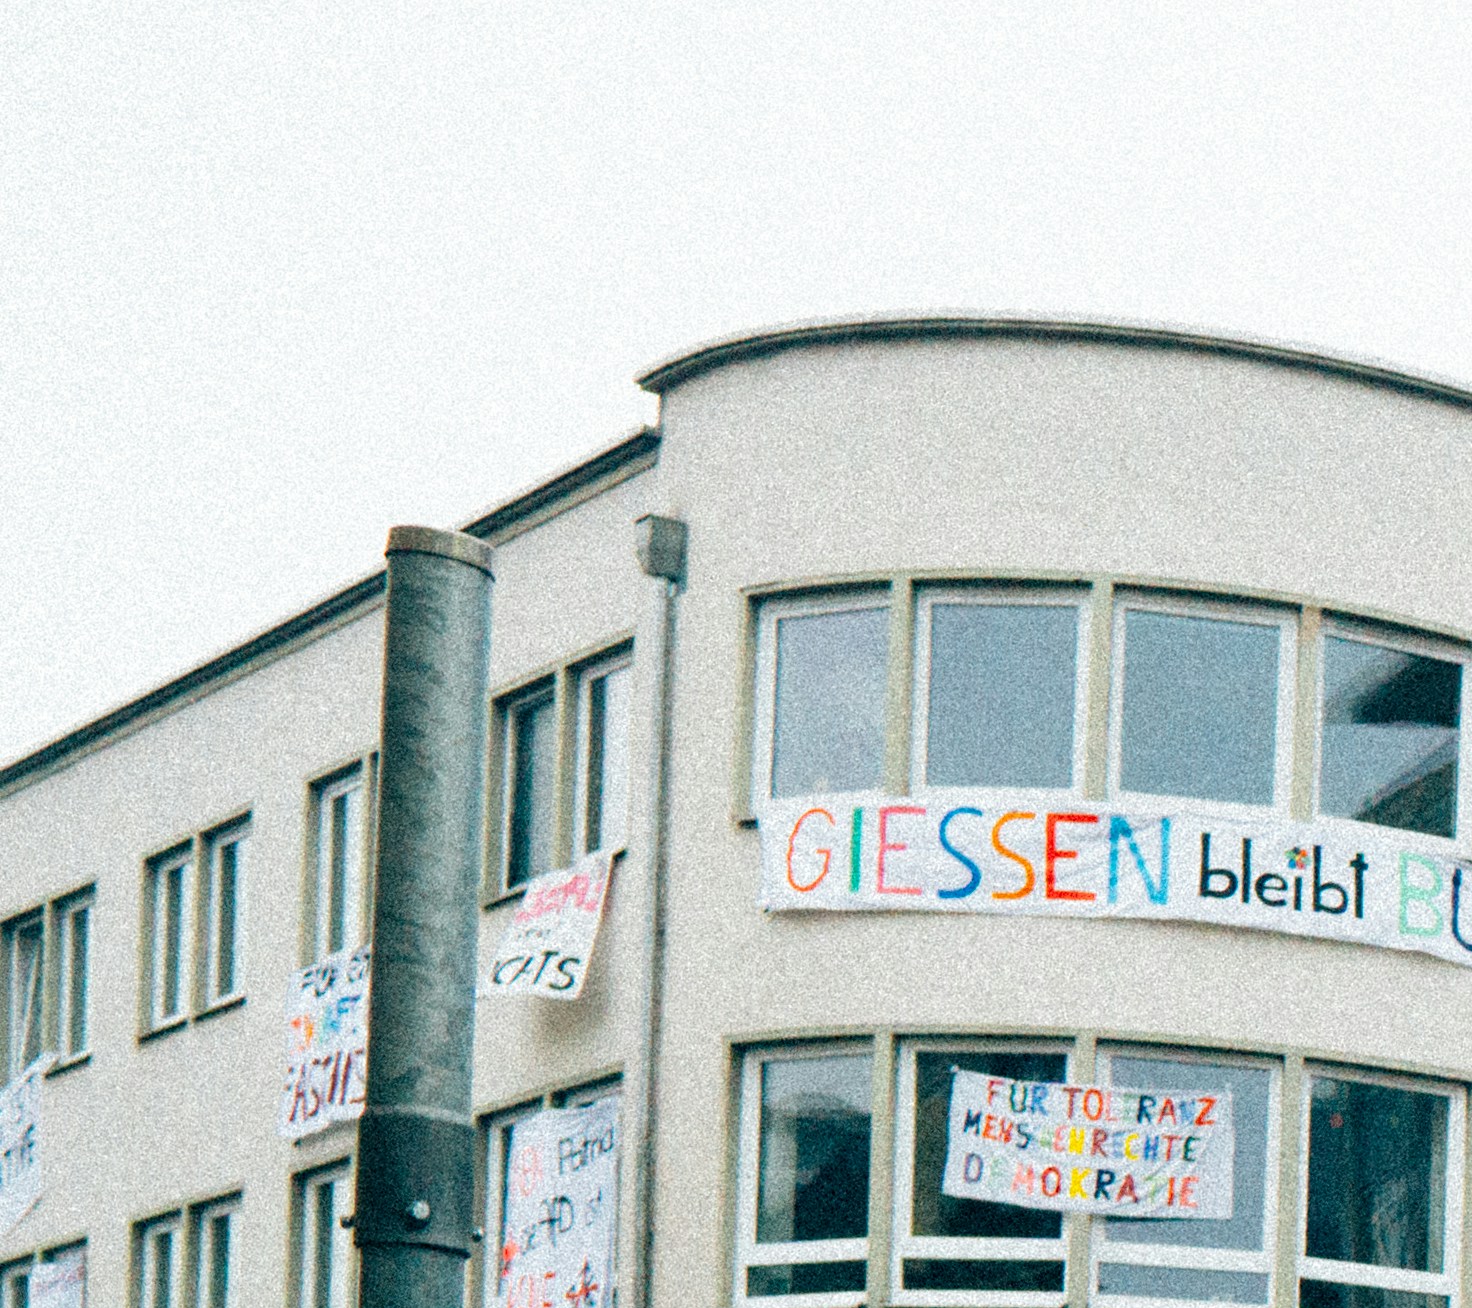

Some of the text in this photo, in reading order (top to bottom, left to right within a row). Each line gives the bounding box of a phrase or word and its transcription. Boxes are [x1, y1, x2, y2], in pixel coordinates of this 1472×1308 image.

[787, 804, 1172, 907] GIESSEN
[1199, 832, 1367, 922] bleibt
[964, 1109, 1203, 1163] MENSHENRECHTE
[963, 1153, 1200, 1208] DEMOKRATIE
